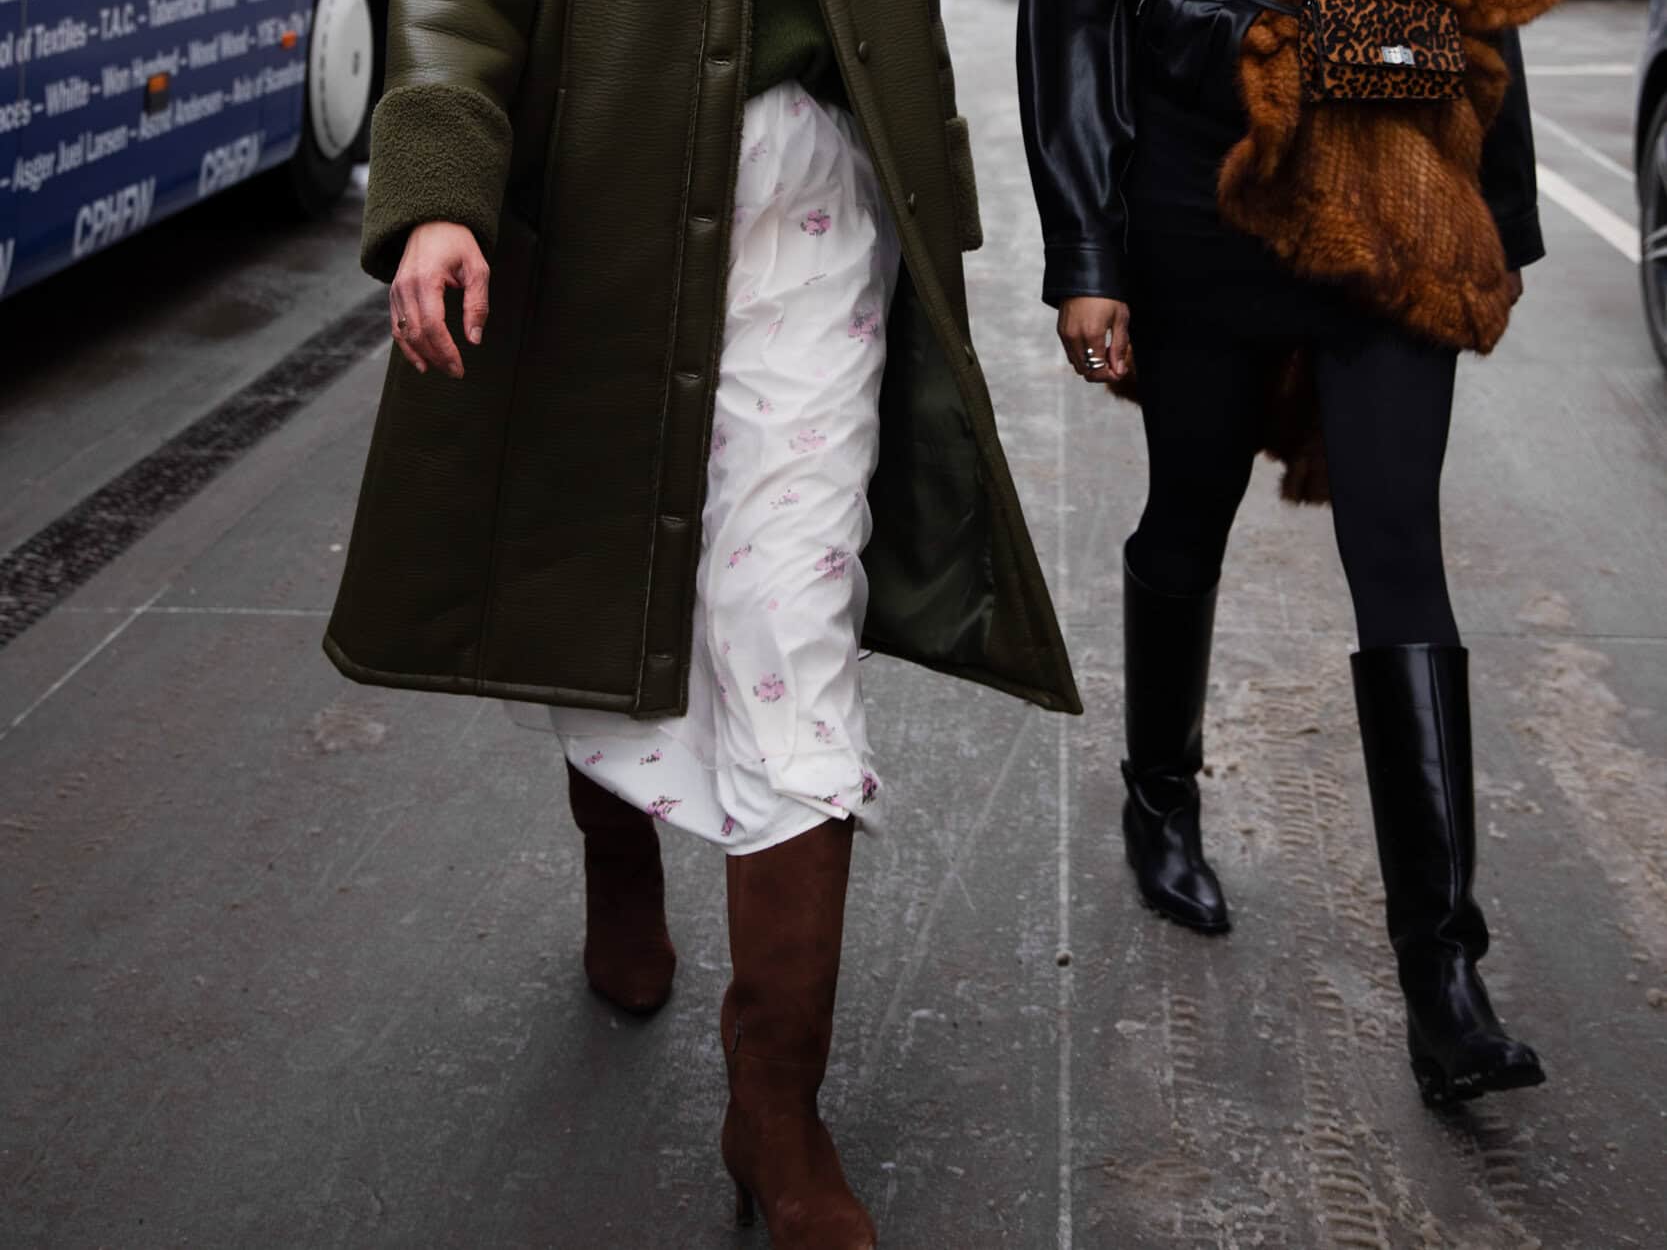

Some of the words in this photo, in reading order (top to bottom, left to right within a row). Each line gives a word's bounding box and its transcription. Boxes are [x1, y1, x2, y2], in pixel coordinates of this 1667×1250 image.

[15, 29, 33, 64] of
[35, 19, 88, 59] Textiles
[45, 78, 91, 118] White
[12, 157, 56, 193] Asger
[56, 135, 84, 174] Juel
[85, 127, 129, 163] Larsen
[198, 133, 266, 200] CPHFW
[73, 178, 156, 259] CPHFW
